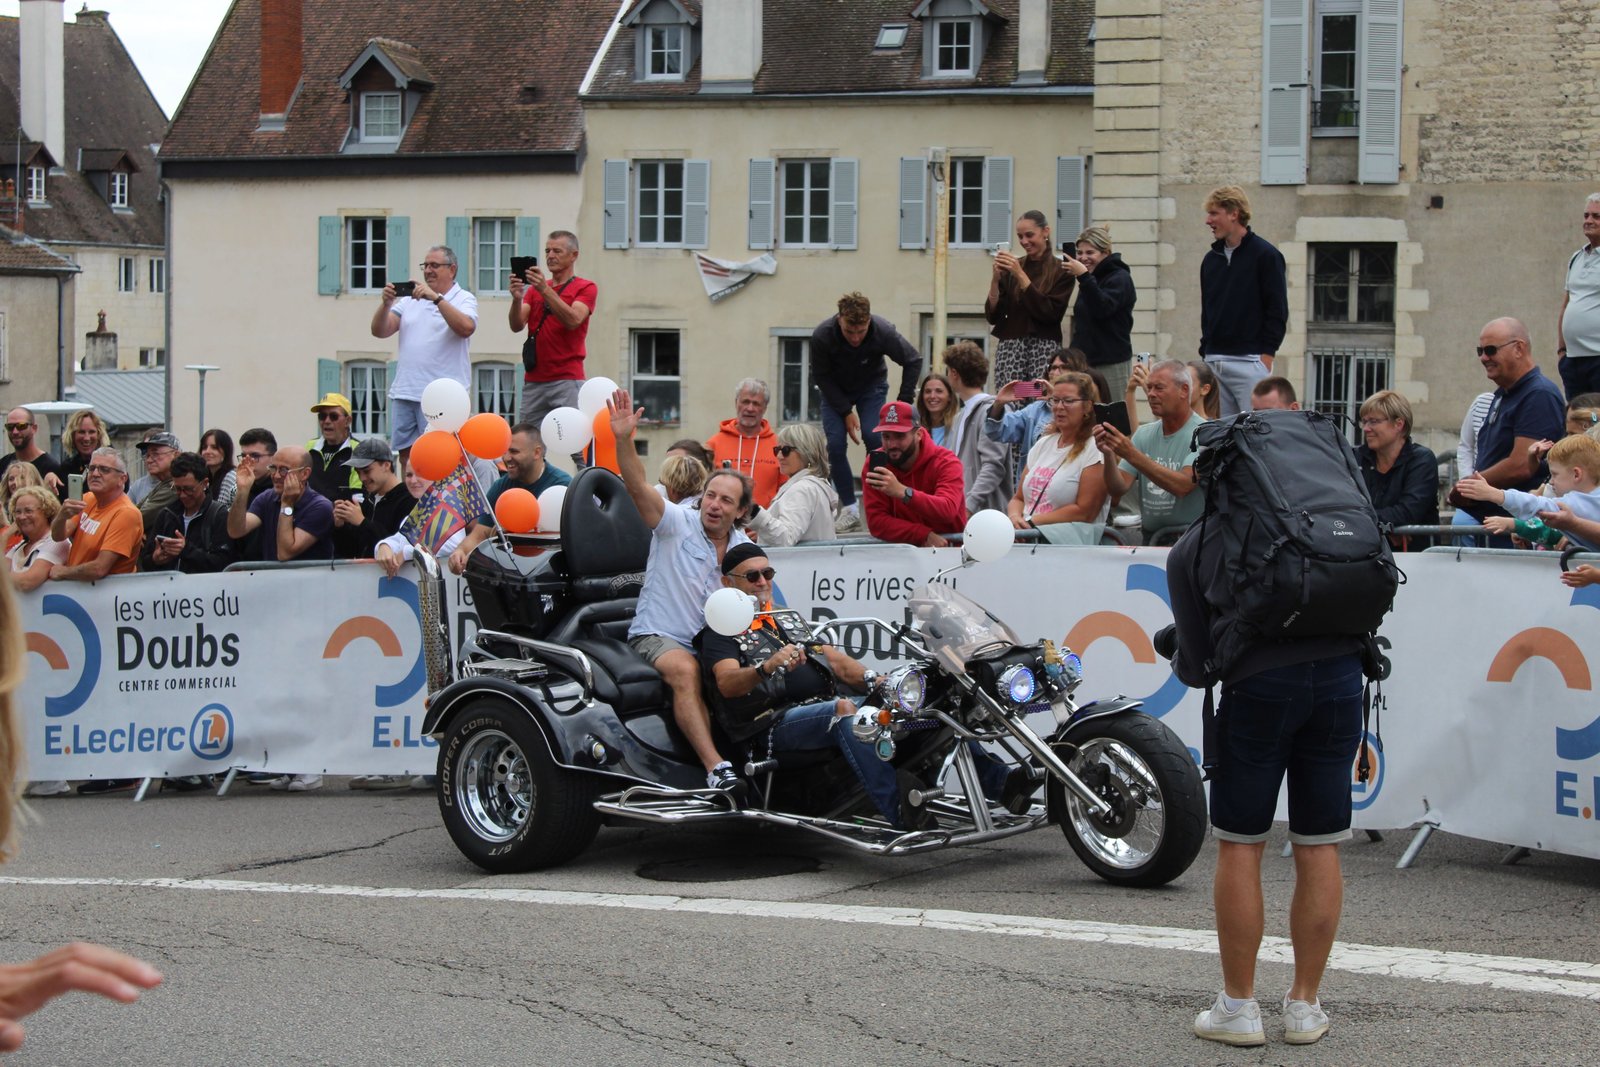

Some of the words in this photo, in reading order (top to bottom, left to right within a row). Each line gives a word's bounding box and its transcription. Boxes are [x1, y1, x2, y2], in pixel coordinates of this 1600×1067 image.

[811, 570, 845, 601] les
[856, 569, 915, 601] rives
[114, 595, 144, 621] les
[153, 593, 204, 619] rives
[213, 589, 240, 616] du
[117, 622, 240, 671] Doubs
[119, 679, 159, 692] CENTRE
[164, 676, 237, 690] COMMERCIAL
[45, 722, 186, 755] E.Leclerc
[442, 736, 460, 807] COOPER
[461, 717, 502, 735] COBRA
